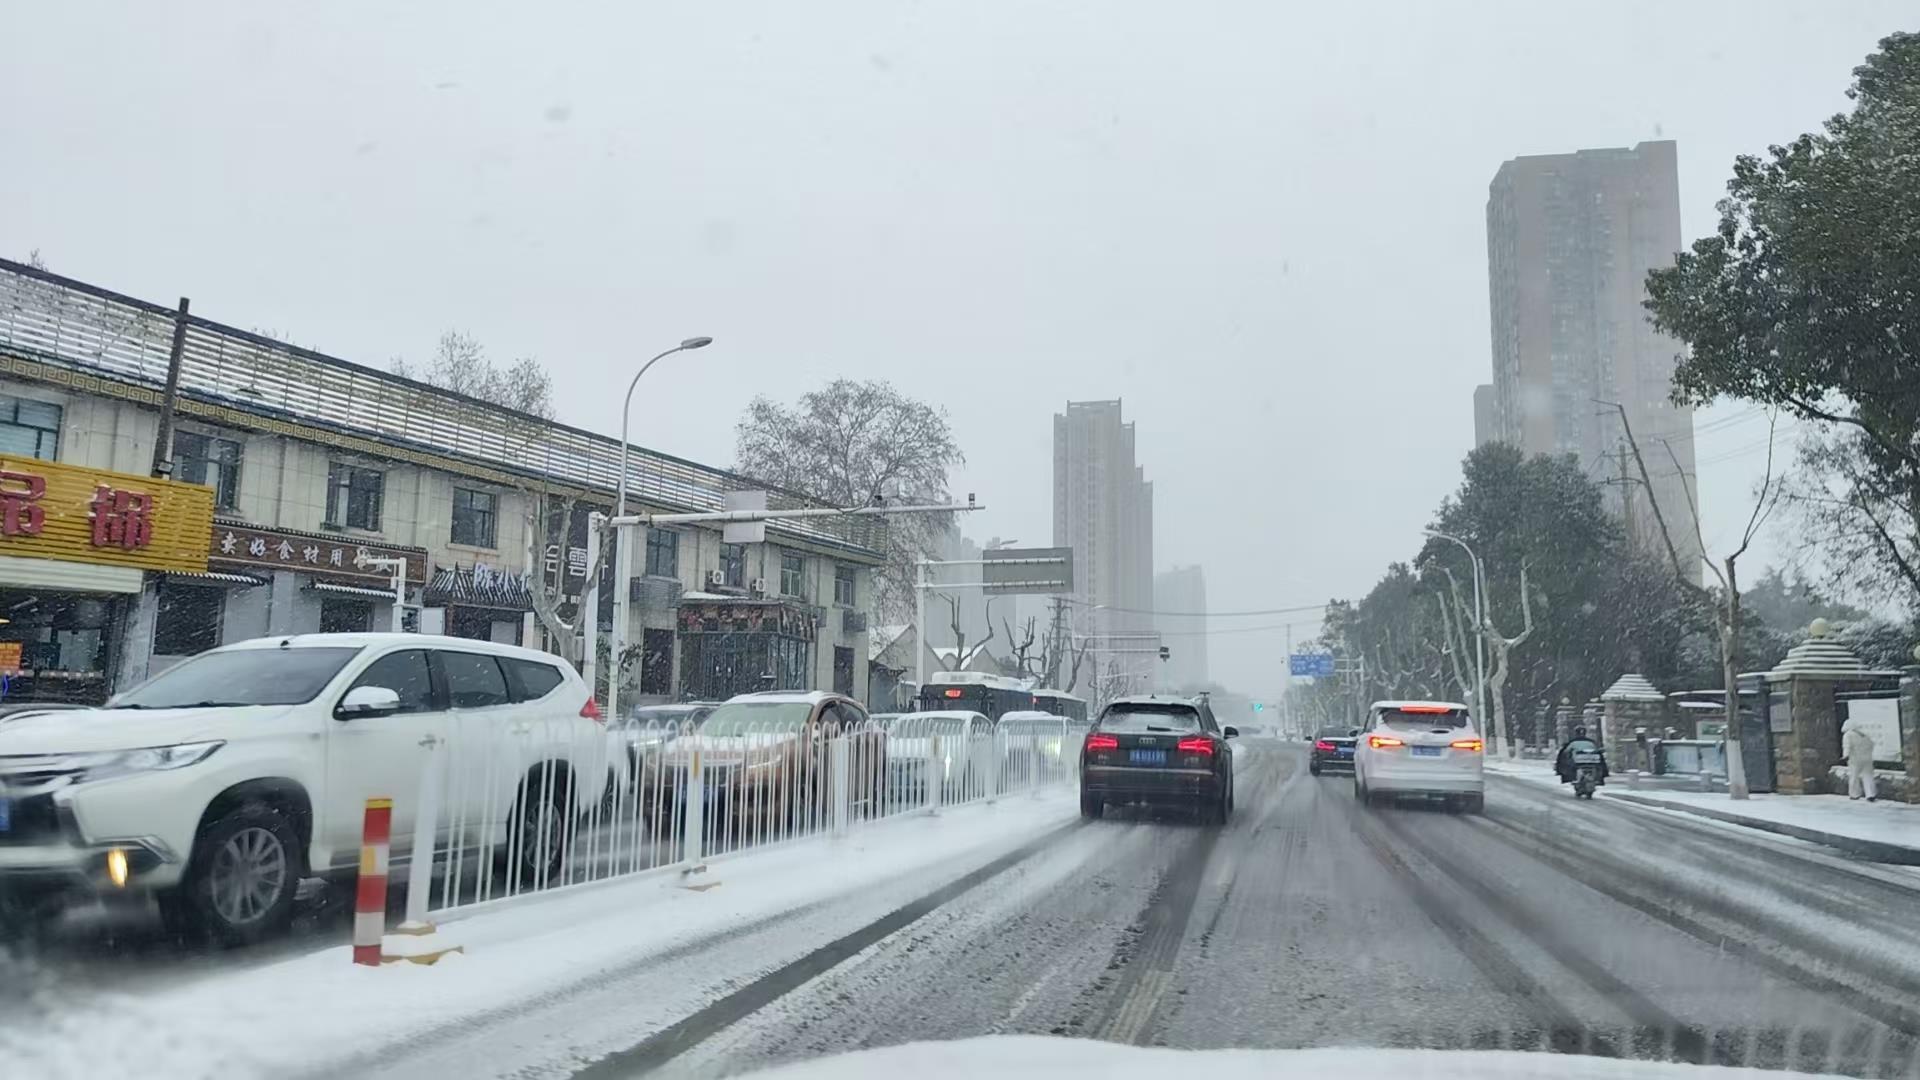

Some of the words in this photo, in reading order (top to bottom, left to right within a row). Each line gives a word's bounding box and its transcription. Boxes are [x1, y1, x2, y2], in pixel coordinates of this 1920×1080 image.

[220, 531, 393, 573] 卖好食材用做
